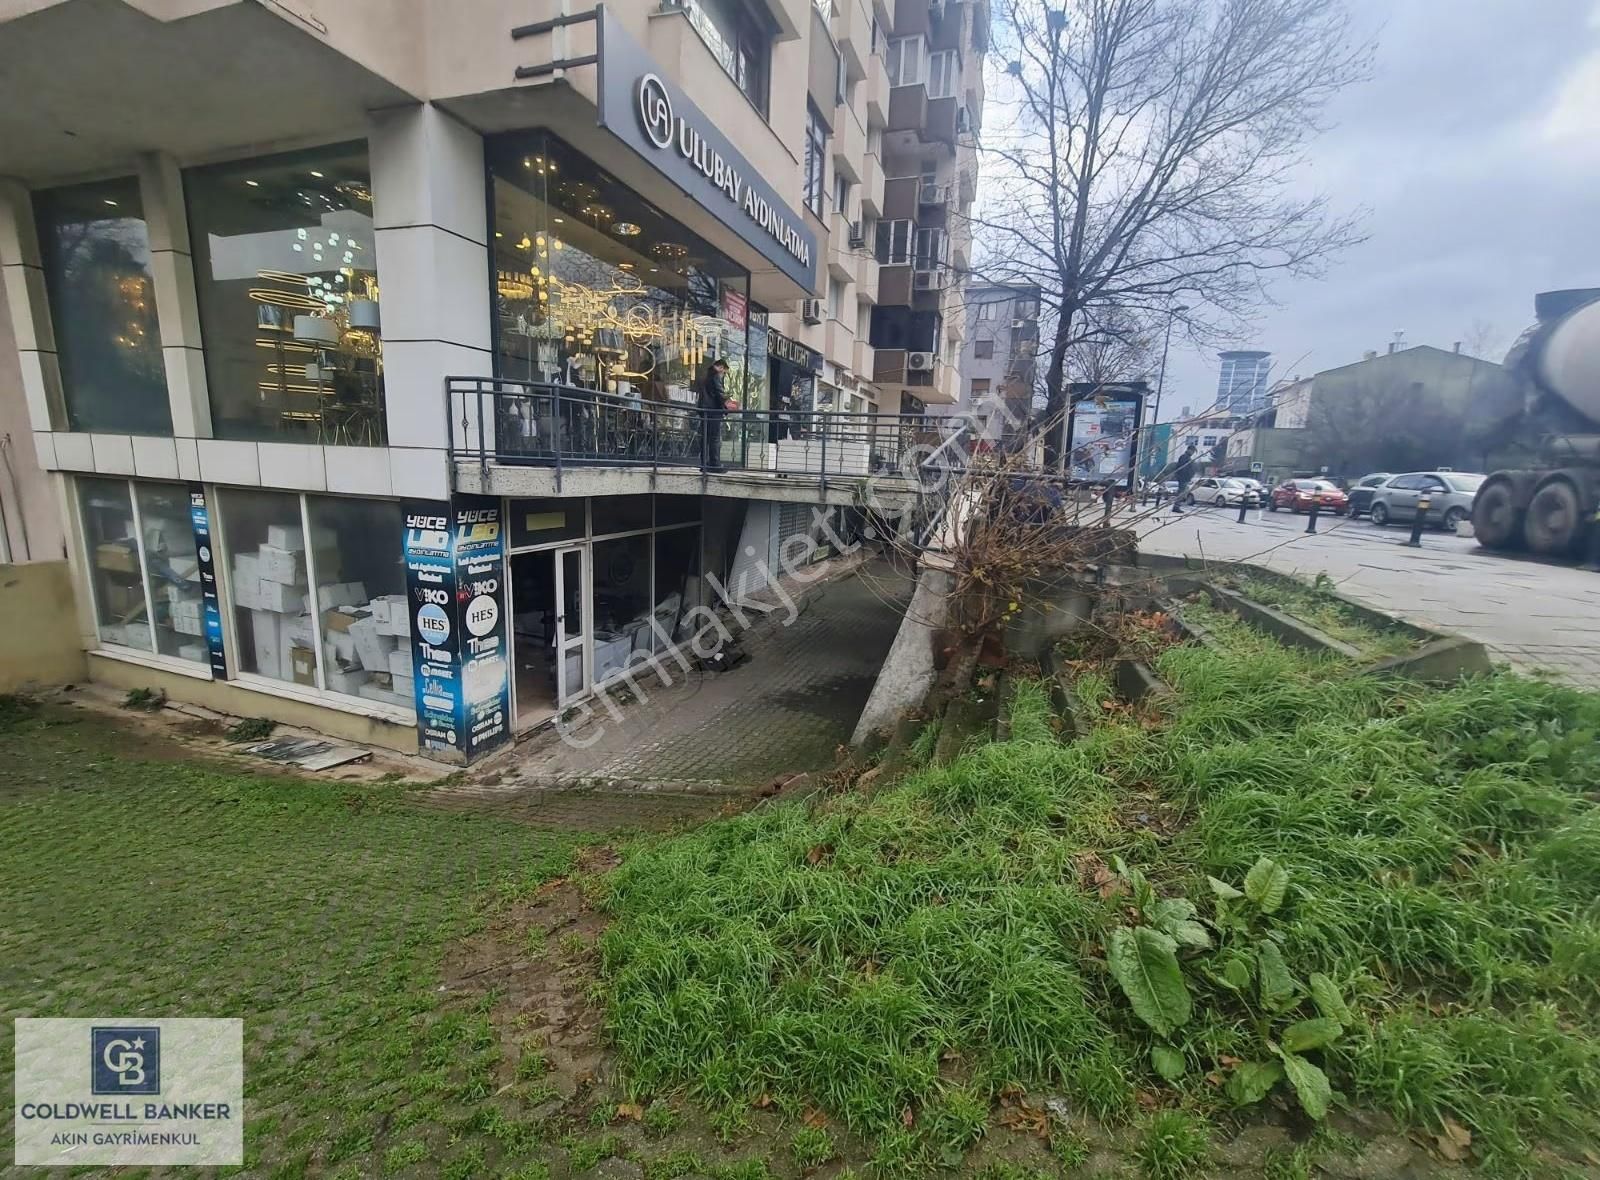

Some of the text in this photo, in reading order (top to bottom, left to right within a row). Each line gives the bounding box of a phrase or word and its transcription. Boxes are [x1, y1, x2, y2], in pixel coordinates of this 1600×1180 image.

[679, 117, 810, 268] ULUBAY AYDINLATMA
[471, 608, 494, 623] HES
[423, 617, 445, 631] HES
